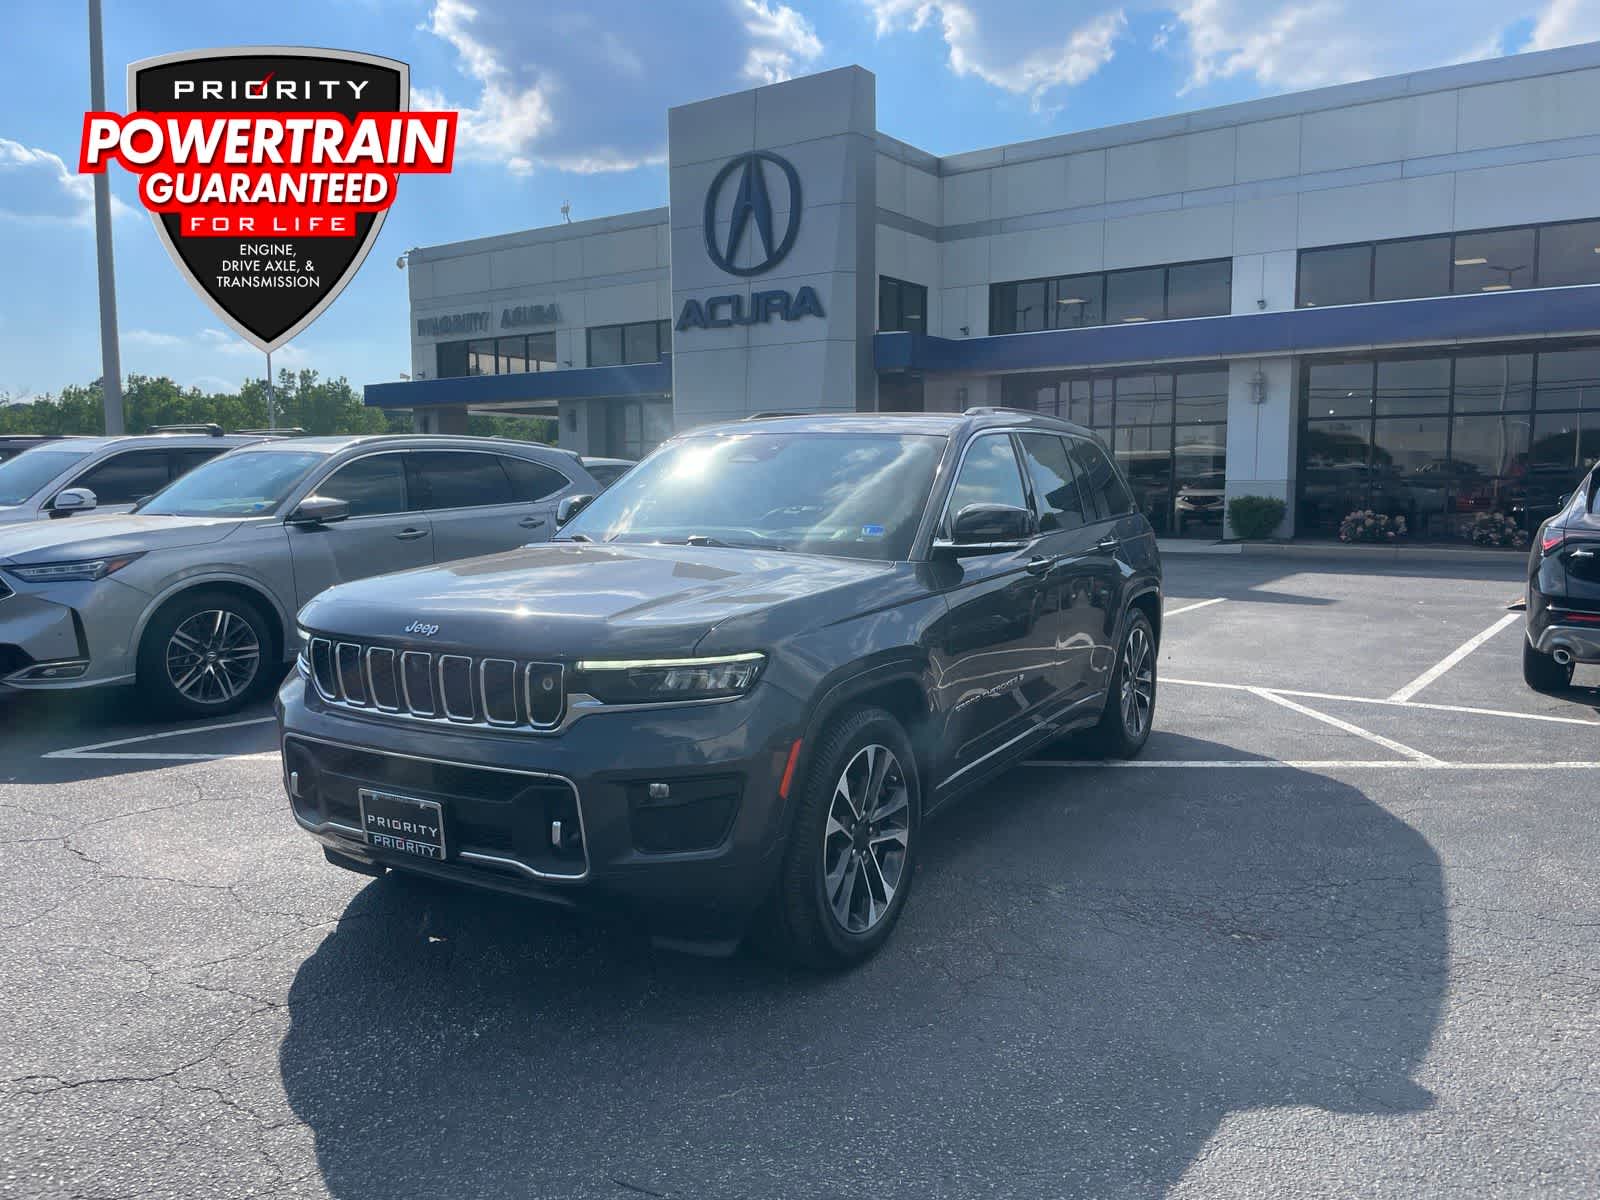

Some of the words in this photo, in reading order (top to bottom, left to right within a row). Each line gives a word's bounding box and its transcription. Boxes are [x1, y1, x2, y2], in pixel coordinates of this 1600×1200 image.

[674, 285, 828, 331] ACURA
[404, 620, 440, 637] Jeep
[367, 814, 438, 838] PRIORITY
[373, 835, 436, 857] PRIORITY
